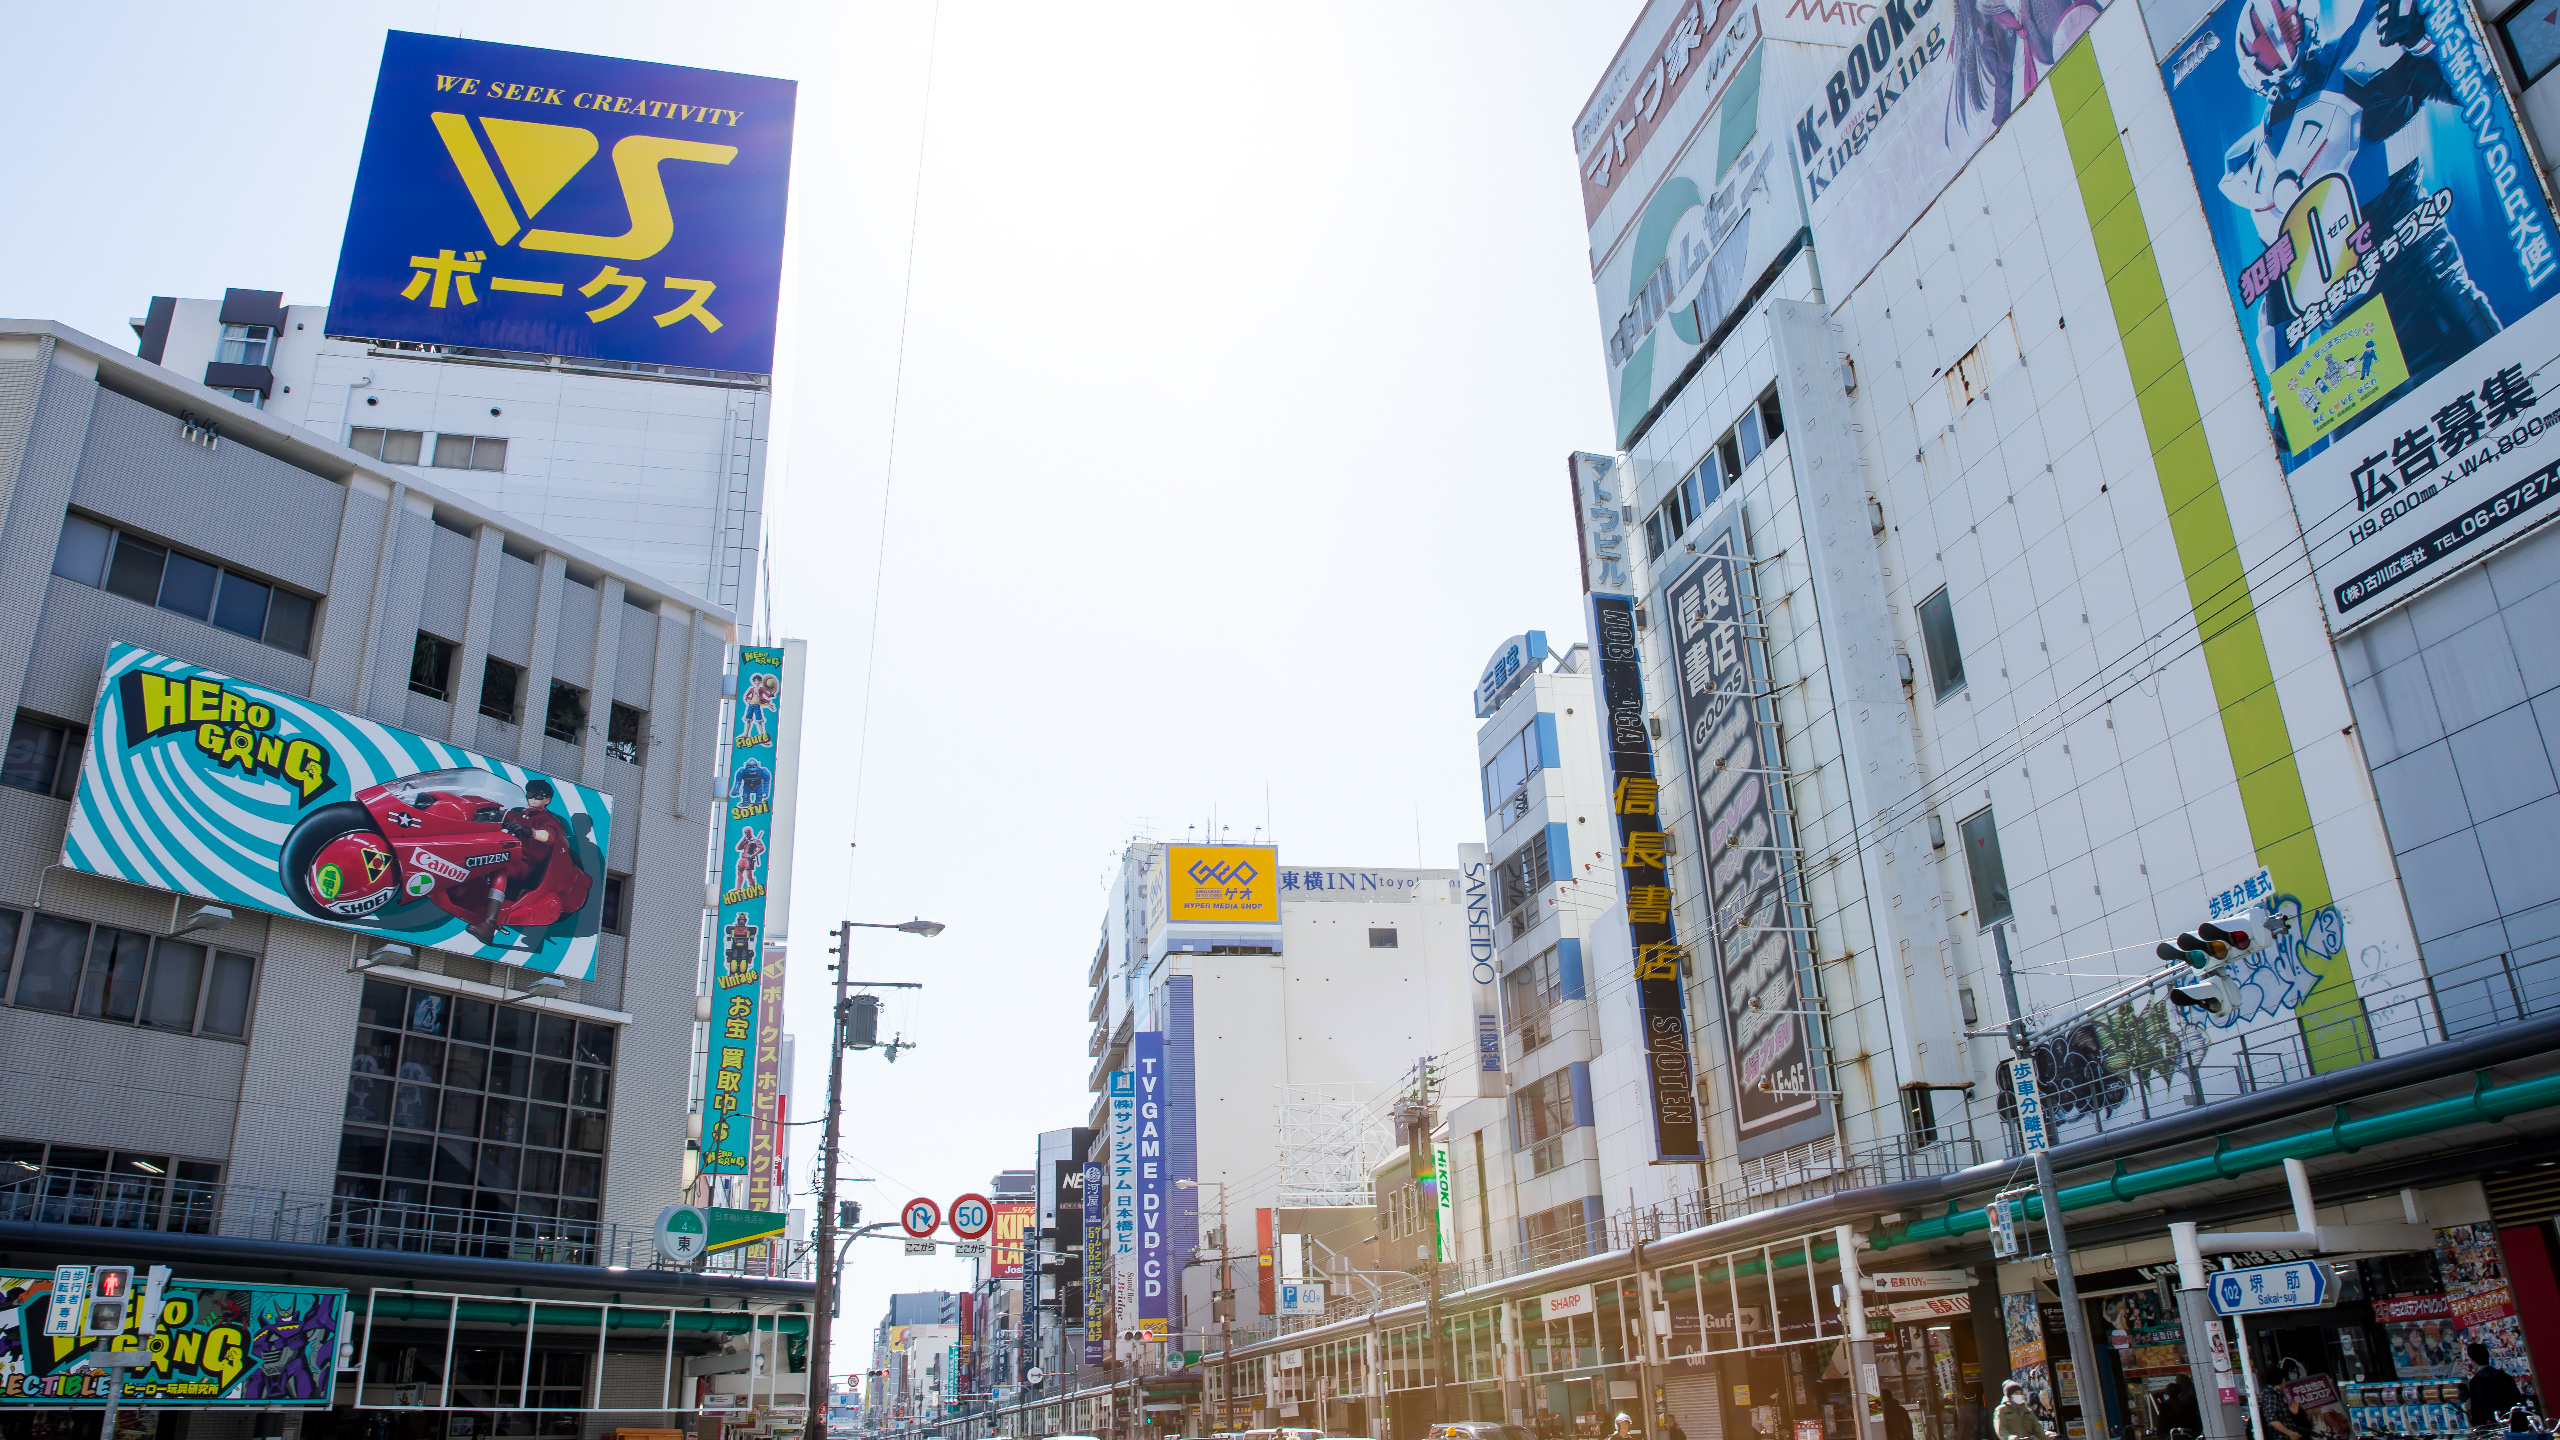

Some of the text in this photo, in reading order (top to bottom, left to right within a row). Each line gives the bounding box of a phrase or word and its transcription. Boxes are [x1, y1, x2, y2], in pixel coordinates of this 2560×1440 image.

[435, 74, 745, 127] WE SEEK CREATIVITY
[400, 249, 724, 334] ボークス
[2312, 412, 2325, 427] WE
[2349, 362, 2537, 512] 広告募集
[1584, 454, 1628, 589] マトウビル
[141, 672, 273, 735] HERO
[1696, 667, 1742, 746] GOODS
[735, 733, 770, 749] Figure
[197, 720, 326, 799] GANG
[1704, 740, 1751, 815] VIDEO
[731, 801, 770, 820] Sofvi
[1711, 779, 1757, 852] DVD
[415, 851, 470, 883] Canon
[465, 851, 511, 868] CITIZEN
[1187, 859, 1259, 886] GEO
[1225, 887, 1253, 900] ゲオ
[1281, 870, 1378, 892] 東横INN
[1612, 776, 1684, 982] 信長書店
[2207, 869, 2273, 919] 歩車分離式
[339, 891, 390, 915] SHOEI
[1464, 862, 1495, 985] SANSEIDO
[717, 969, 758, 990] Vintage
[759, 985, 783, 1064] ボークス
[713, 994, 753, 1115] お宝 買取中
[1745, 1015, 1792, 1083] 精力剤
[1651, 1014, 1693, 1127] SYOTEN
[2014, 1062, 2045, 1152] 歩車分離式
[958, 1206, 984, 1227] 50
[1115, 1195, 1133, 1255] 日本橋ビル
[678, 1236, 691, 1252] 東
[906, 1242, 935, 1252] ここから
[956, 1244, 986, 1254] ここから
[55, 1270, 71, 1304] 自転車
[68, 1270, 85, 1304] 歩行者
[1551, 1294, 1581, 1311] SHARP
[2223, 1285, 2240, 1300] 102
[2258, 1290, 2298, 1305] Sakai-suji
[56, 1307, 70, 1331] 専用
[1023, 1256, 1034, 1364] WINDOWS TOWER
[1704, 1312, 1734, 1329] Guf
[2375, 1302, 2389, 1320] 2F
[1285, 1353, 1297, 1365] NEC
[124, 1383, 219, 1395] ヒーロー玩具研究所
